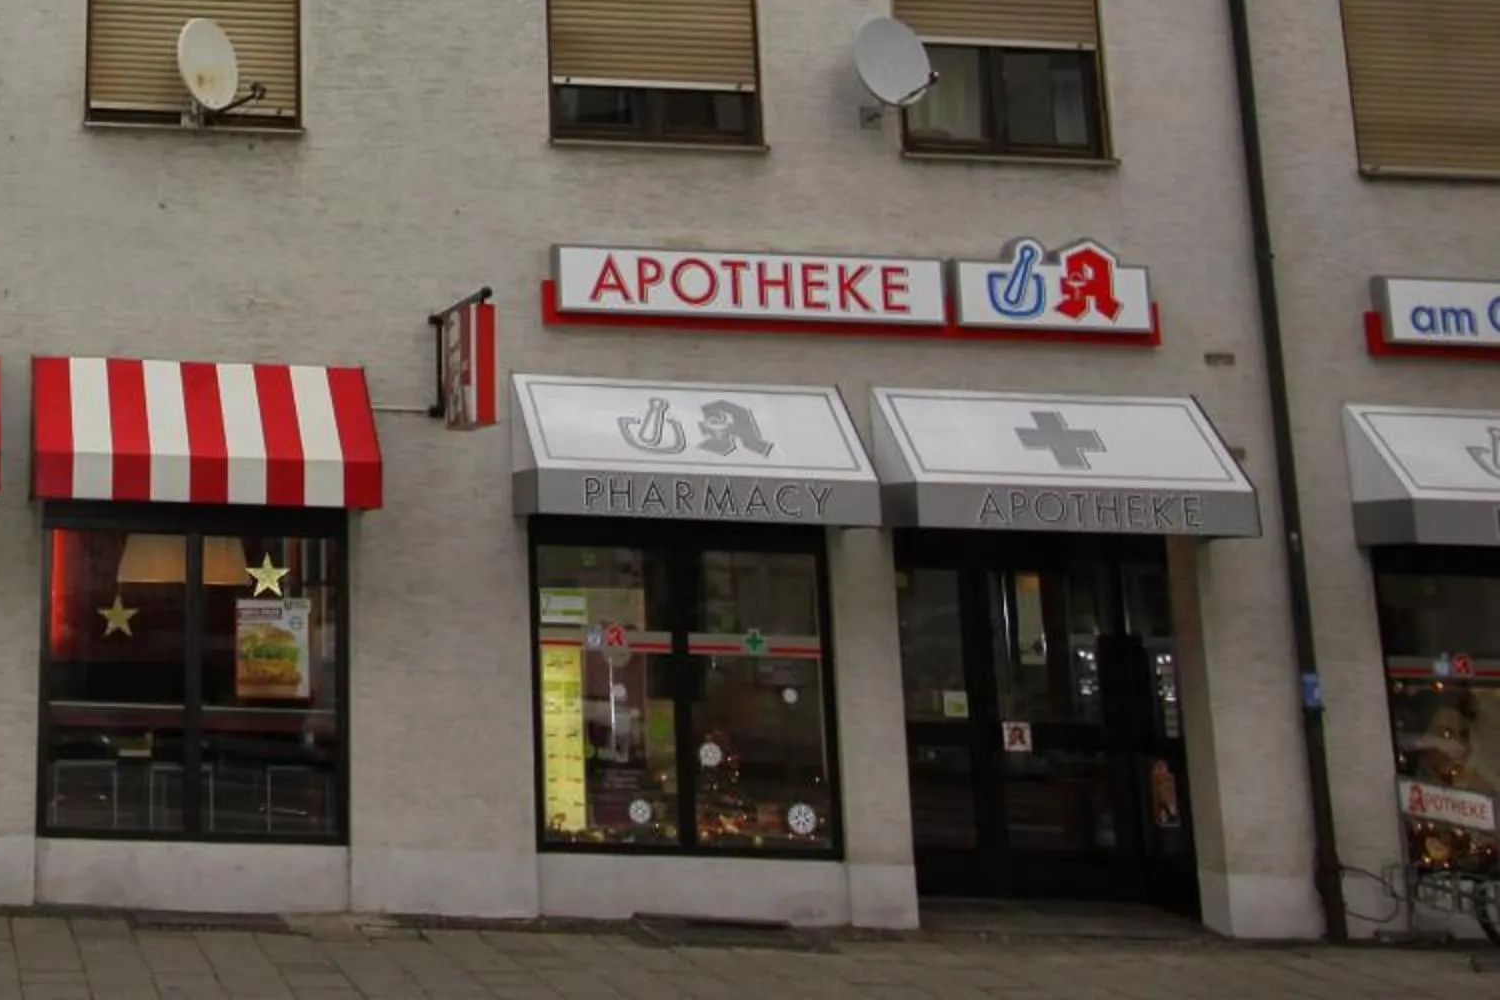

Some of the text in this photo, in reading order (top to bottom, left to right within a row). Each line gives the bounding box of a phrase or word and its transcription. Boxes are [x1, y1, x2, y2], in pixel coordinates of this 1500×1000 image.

[589, 252, 911, 313] APOTHEKE
[1410, 303, 1479, 337] am
[583, 476, 835, 519] PHARMACY
[978, 487, 1204, 530] APOTHEKE
